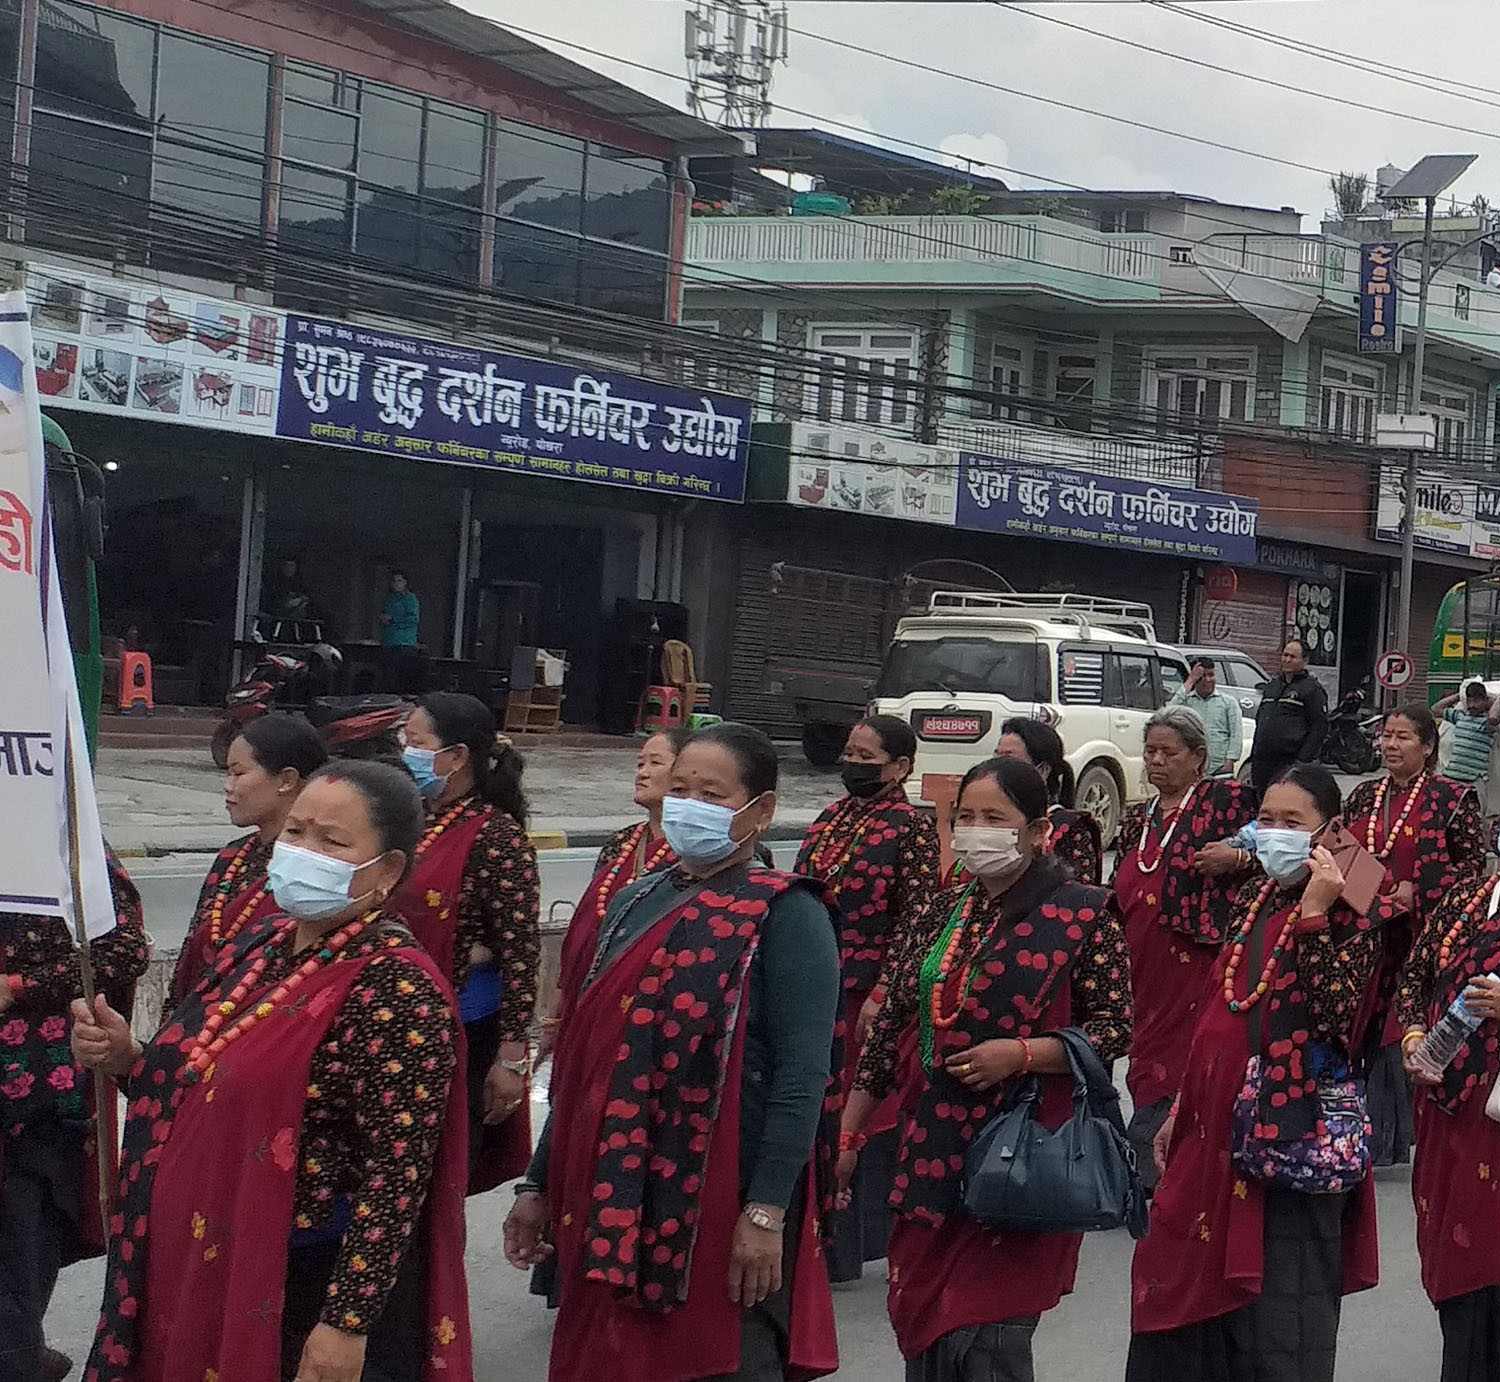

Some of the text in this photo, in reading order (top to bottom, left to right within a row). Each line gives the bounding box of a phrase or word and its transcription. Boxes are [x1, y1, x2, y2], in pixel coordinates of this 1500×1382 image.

[294, 341, 743, 461] शुभ बुद्ध दर्शन फर्निचर उद्योग
[967, 468, 1012, 509] शुभ
[1058, 480, 1116, 518] दर्शन
[1121, 487, 1201, 532] फर्निचर
[1205, 500, 1258, 537] उद्योग
[1260, 544, 1316, 570] POKHARA
